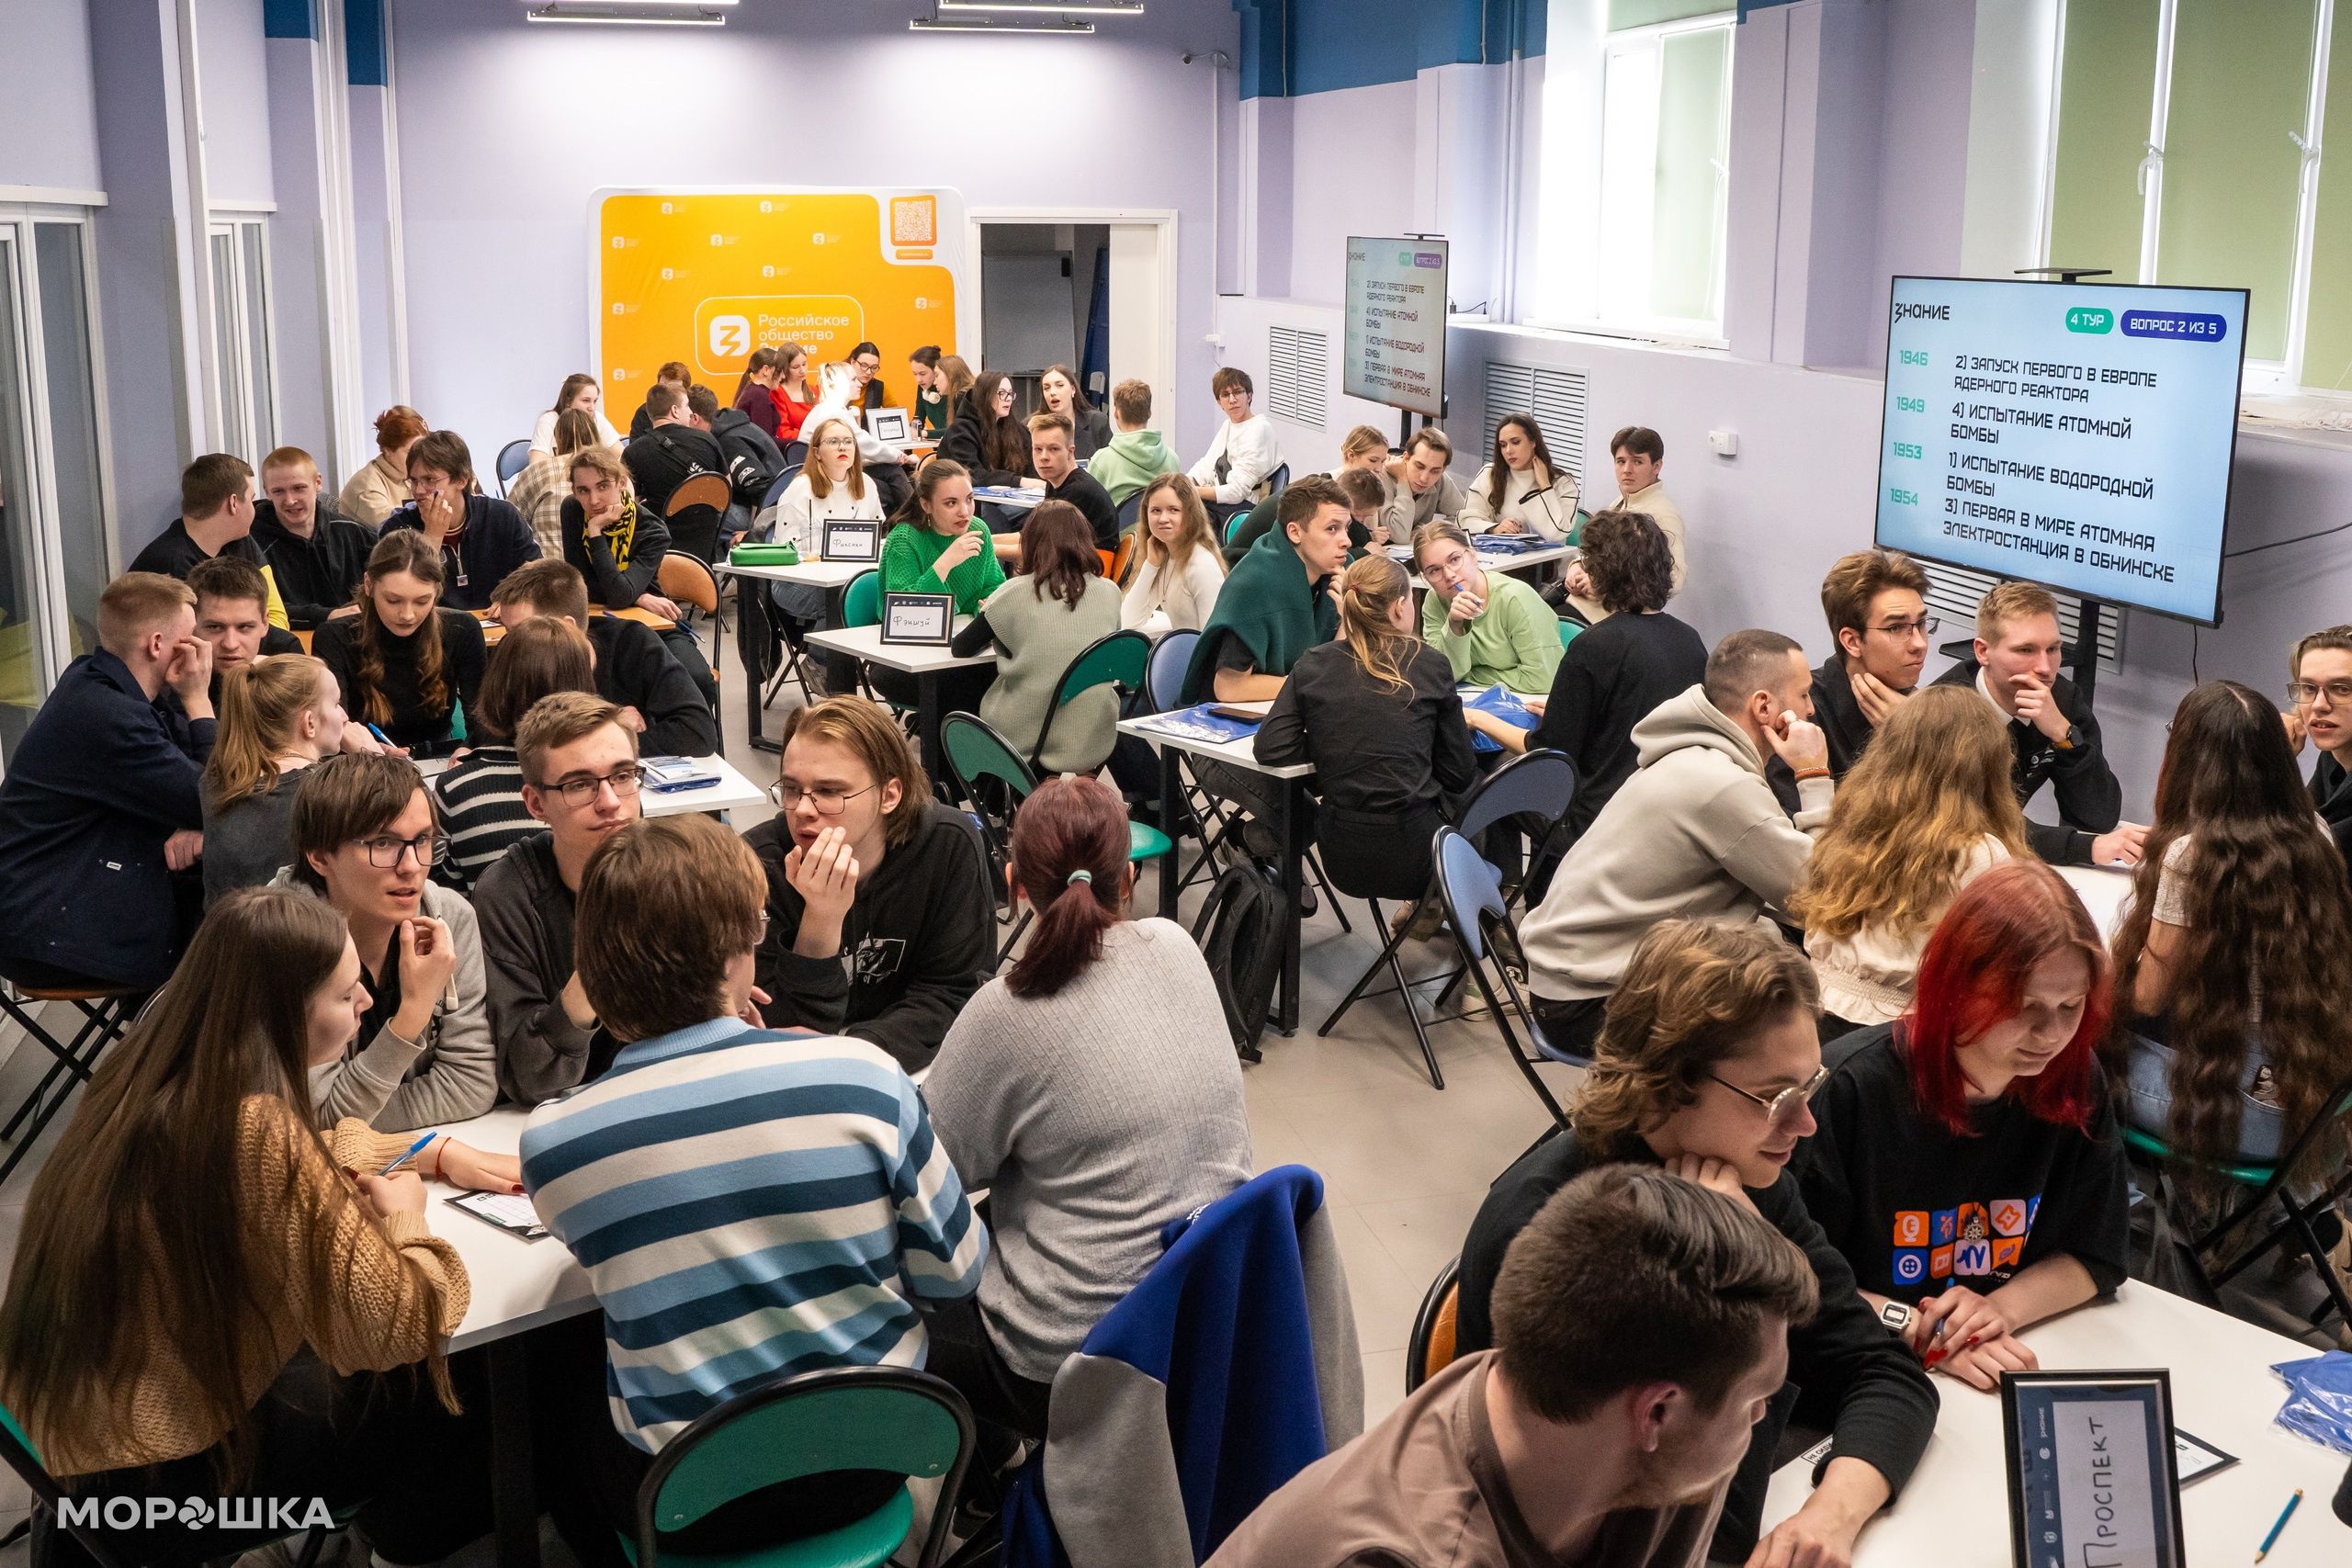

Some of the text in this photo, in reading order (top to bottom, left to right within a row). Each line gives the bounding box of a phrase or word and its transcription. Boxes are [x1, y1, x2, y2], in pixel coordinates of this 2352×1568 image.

[758, 313, 850, 327] Российское
[2070, 313, 2105, 327] 4 ТУР
[2131, 318, 2217, 335] ВОПРОС 2 ИЗ 5
[758, 329, 834, 344] общество
[1900, 349, 1928, 366] 1946
[1955, 355, 2157, 388] 2) ЗАПУСК ПЕРВОГО В ЕВРОПЕ
[1954, 376, 2088, 403] ЯДЕРНОГО РЕАКТОРА
[1896, 396, 1925, 412] 1949
[1952, 401, 2132, 439] 4) ИСПЫТАНИЕ АТОМНОЙ
[1951, 423, 1999, 444] БОМБЫ
[1894, 442, 1922, 459] 1953
[1949, 452, 2154, 500] 1) ИСПЫТАНИЕ ВОДОРОДНОЙ
[1947, 475, 1996, 497] БОМБЫ
[1891, 488, 1918, 506] 1954
[1945, 498, 2155, 552] 3) ПЕРВАЯ В МИРЕ АТОМНАЯ
[1943, 521, 2175, 583] ЭЛЕКТРОСТАНЦИЯ В ОБНИНСКЕ
